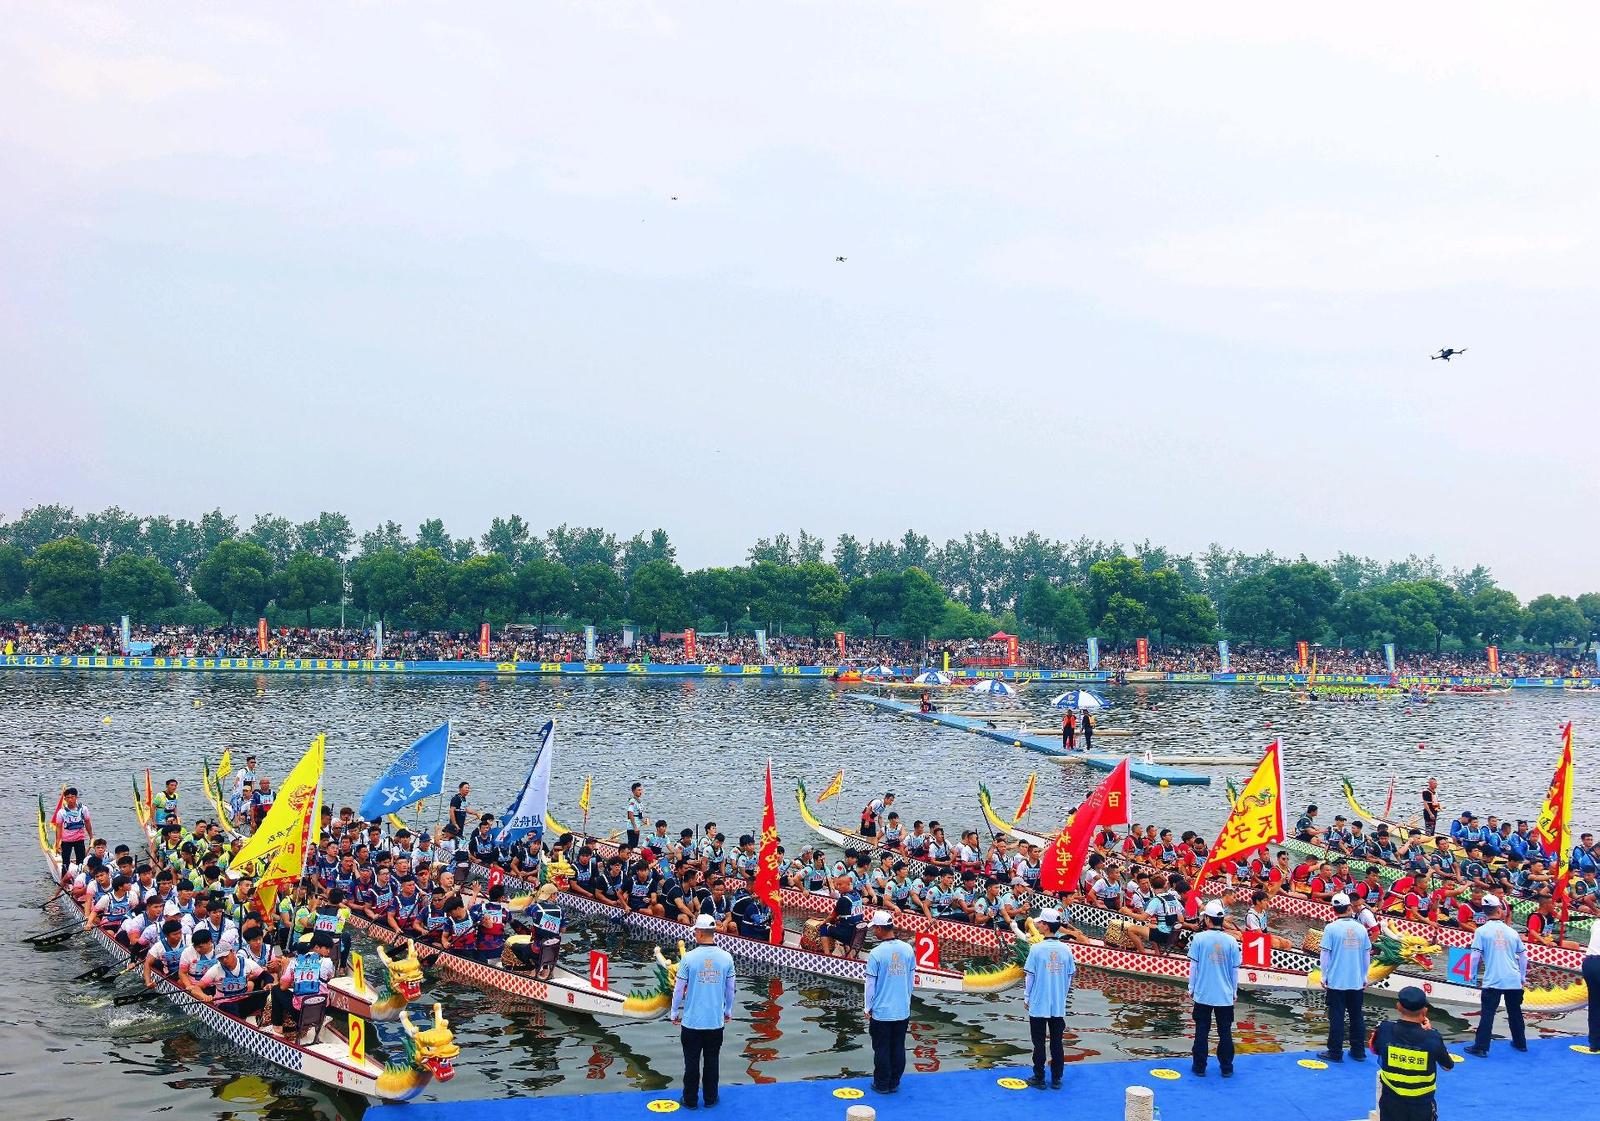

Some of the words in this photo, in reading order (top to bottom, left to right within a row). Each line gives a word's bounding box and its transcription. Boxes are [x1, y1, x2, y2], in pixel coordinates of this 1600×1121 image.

[919, 937, 935, 967] 2
[1248, 936, 1265, 965] 1
[300, 970, 314, 981] 16
[355, 958, 363, 989] 1
[593, 956, 605, 988] 4
[1452, 953, 1472, 982] 4
[351, 1020, 362, 1060] 2
[652, 1101, 675, 1109] 12
[838, 1089, 860, 1098] 10
